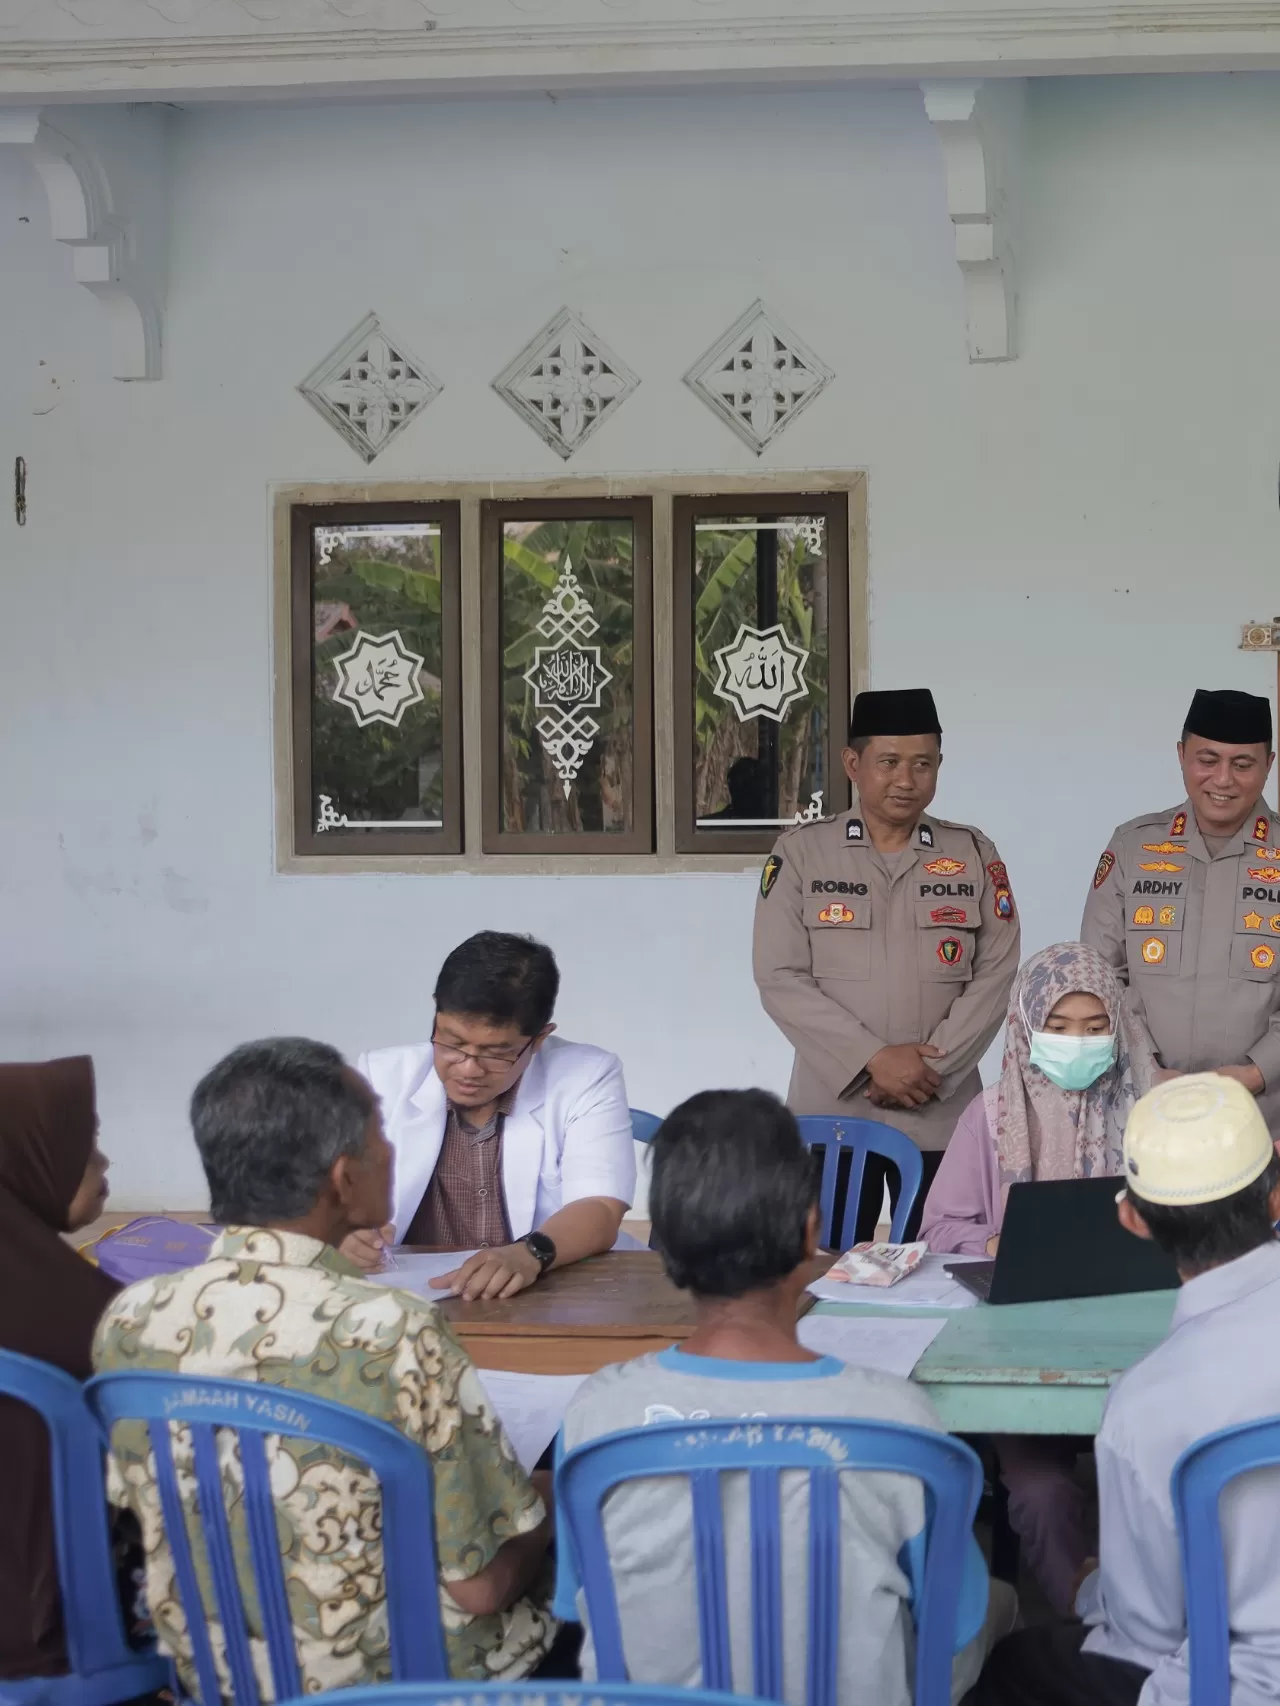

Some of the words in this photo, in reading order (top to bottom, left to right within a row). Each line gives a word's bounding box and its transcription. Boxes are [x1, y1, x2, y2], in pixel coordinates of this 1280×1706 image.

[811, 879, 868, 896] ROBIG
[920, 883, 974, 897] POLRI
[1132, 880, 1183, 896] ARDHY
[245, 1394, 312, 1432] YASIN
